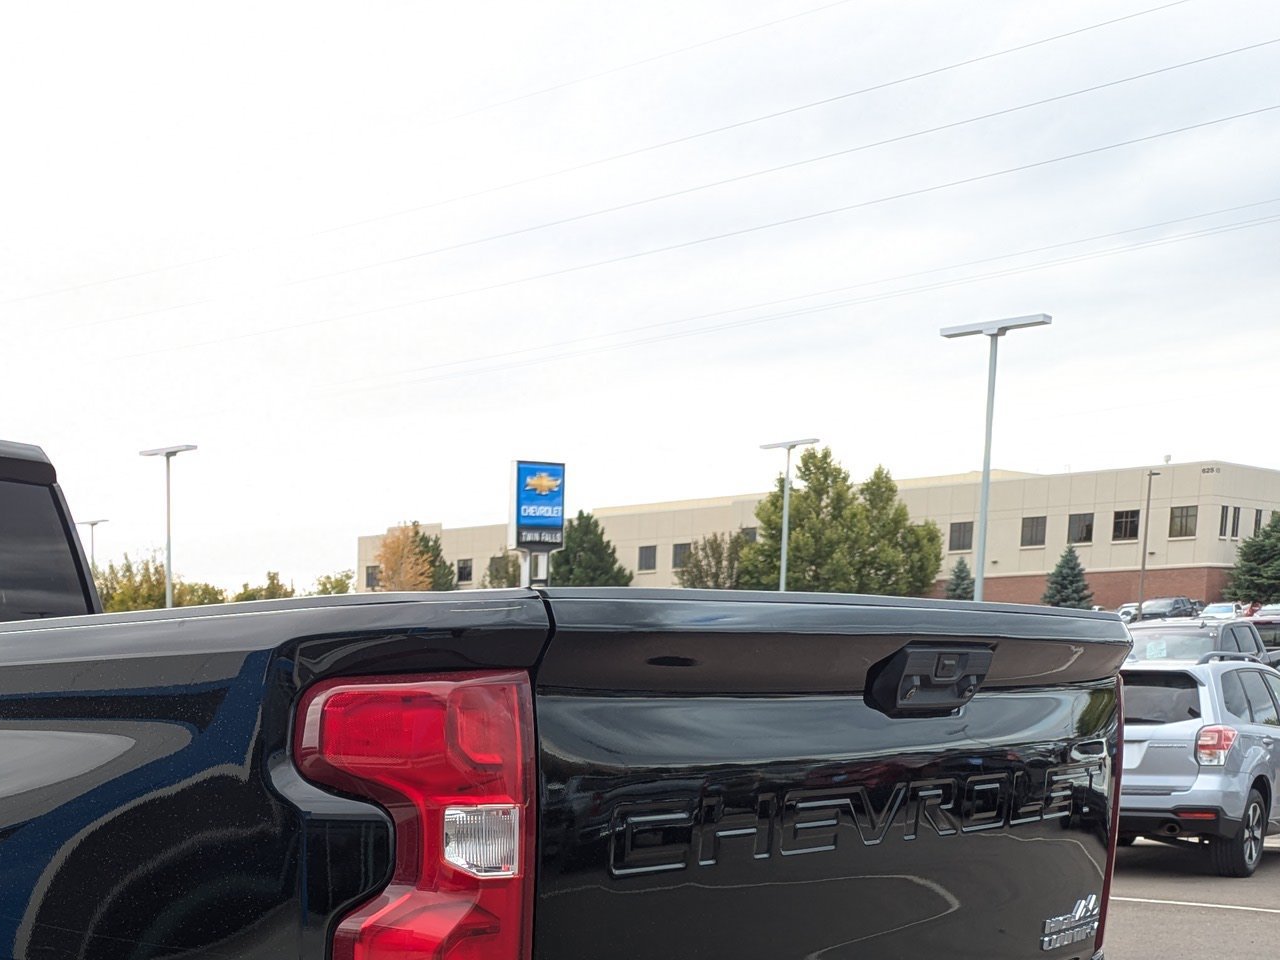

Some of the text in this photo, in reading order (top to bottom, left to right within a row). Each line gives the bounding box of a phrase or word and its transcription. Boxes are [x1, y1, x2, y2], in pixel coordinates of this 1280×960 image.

[521, 505, 563, 517] CHEVROLET
[521, 531, 562, 543] TWIN FALLS
[610, 762, 1104, 879] CHEVROLET
